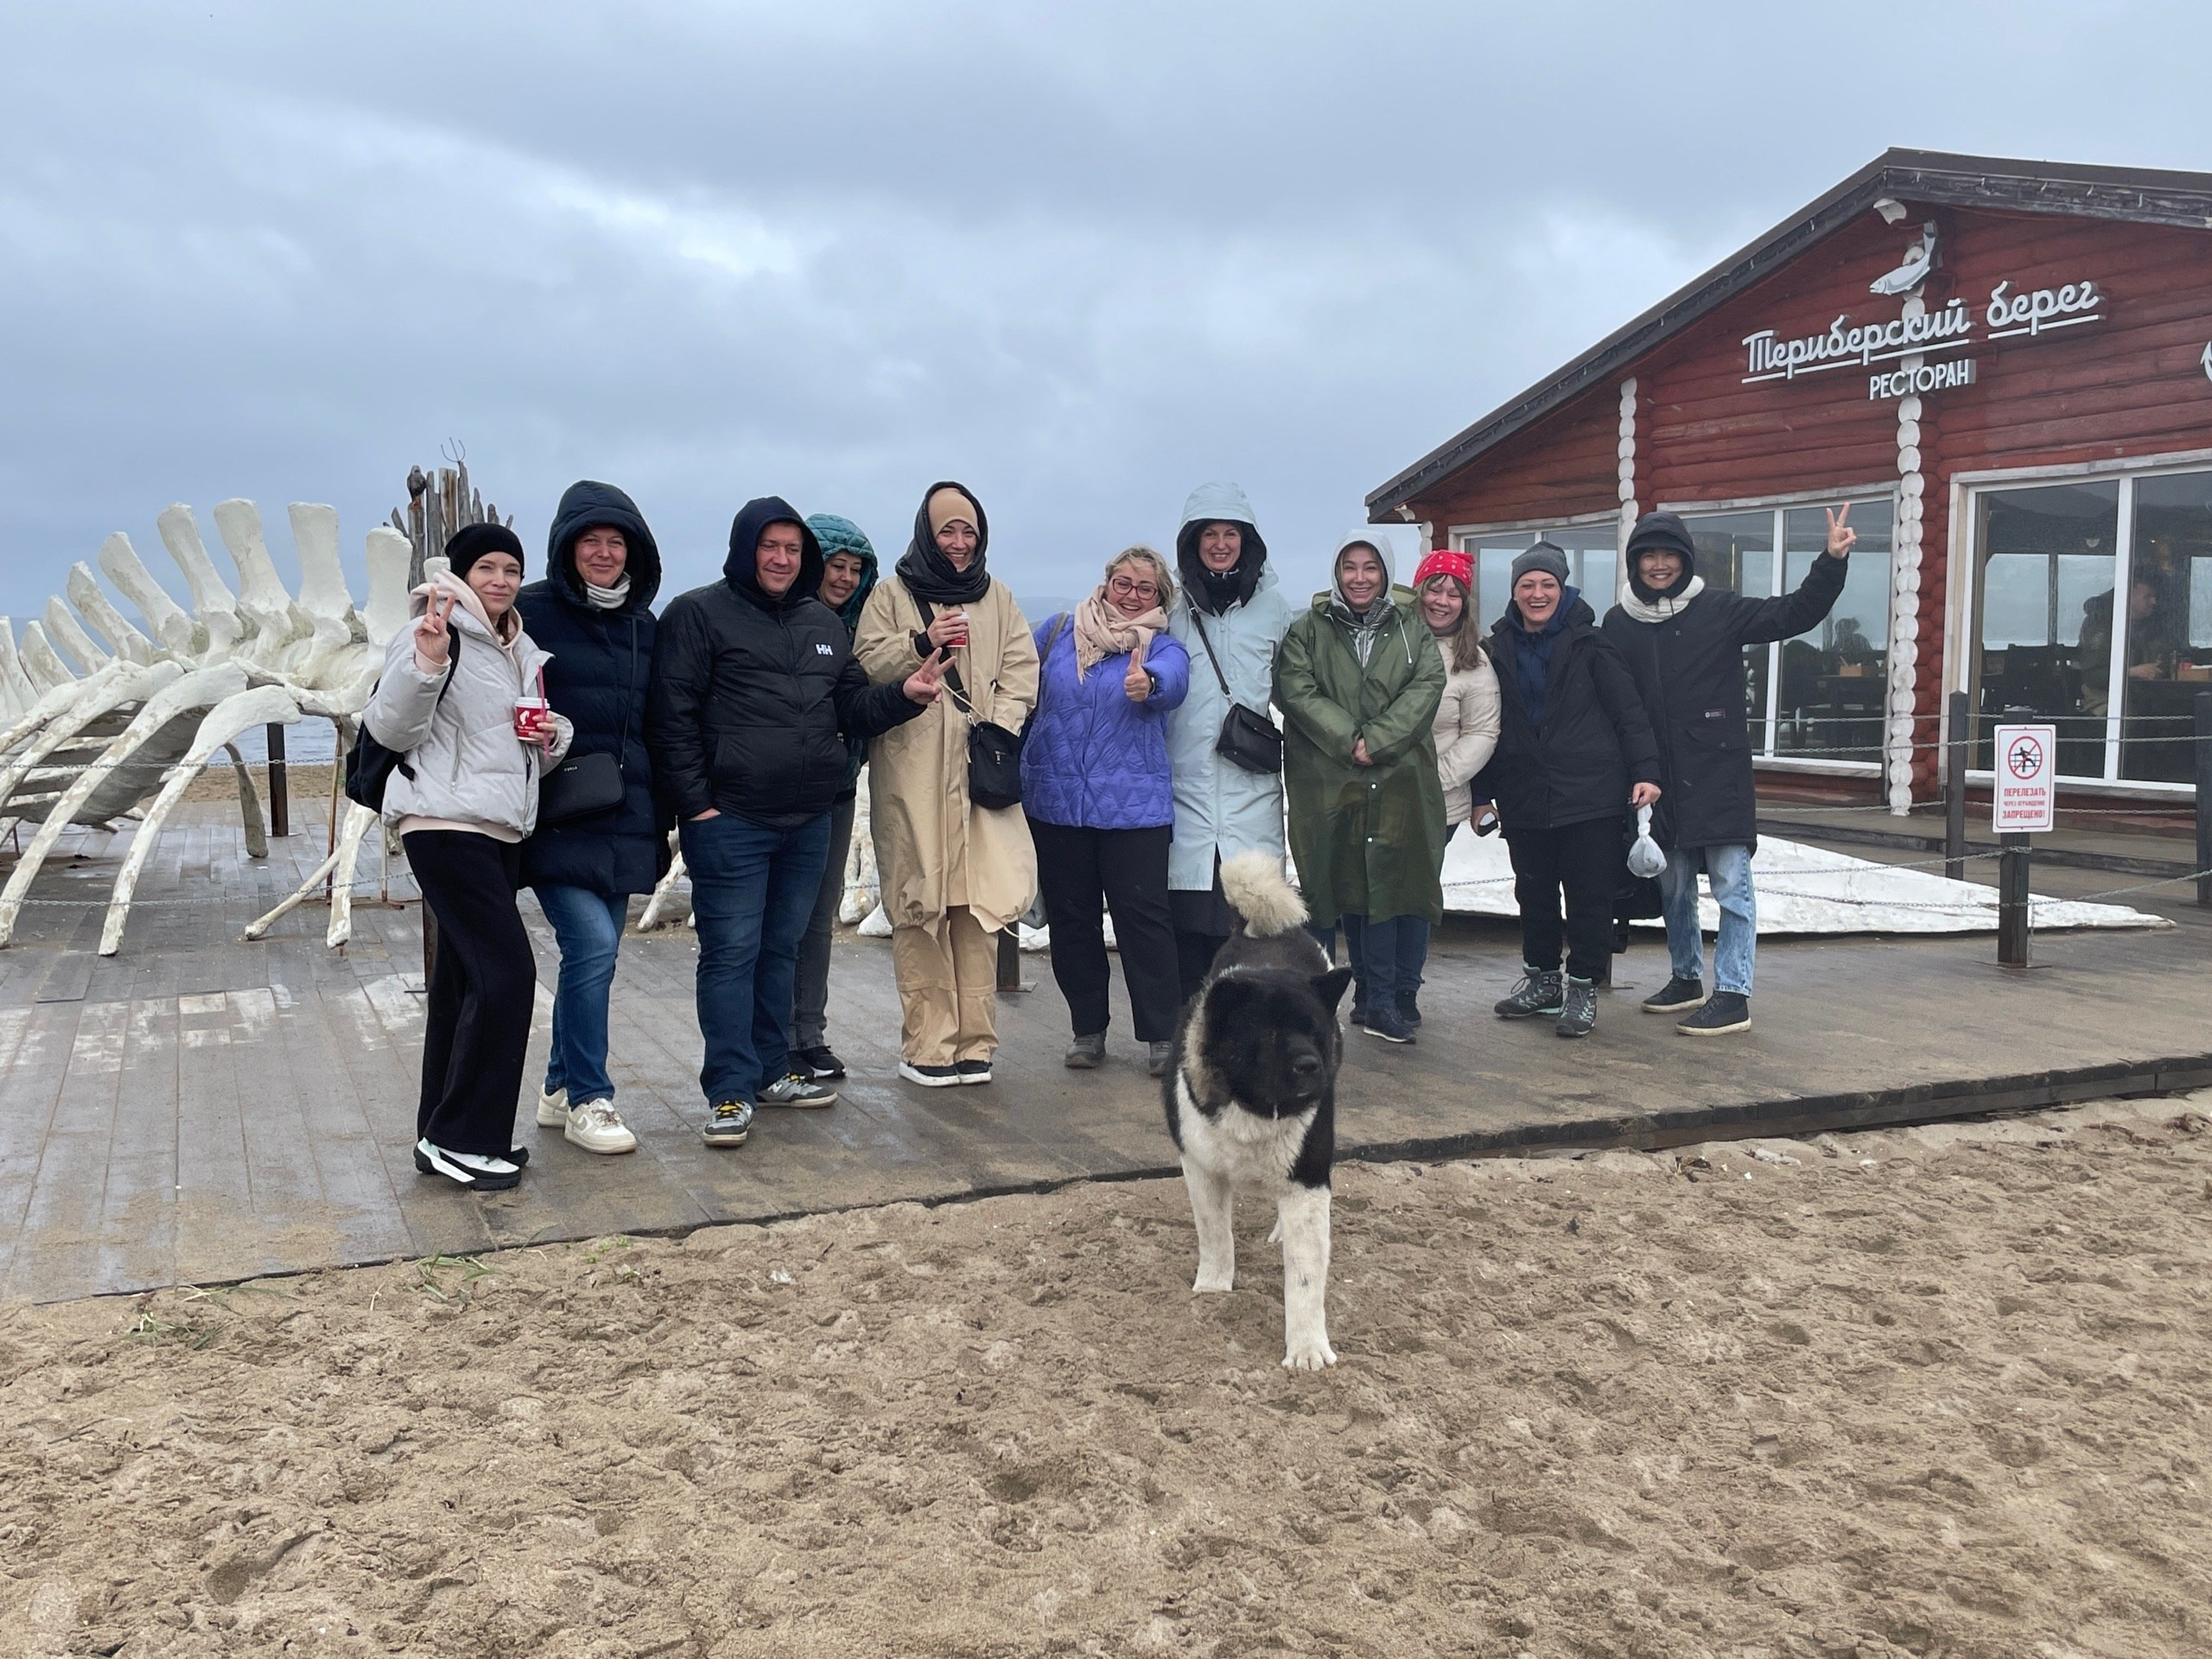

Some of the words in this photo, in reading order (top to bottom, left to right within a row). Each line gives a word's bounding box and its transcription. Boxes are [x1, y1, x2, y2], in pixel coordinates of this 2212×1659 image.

[1742, 298, 1971, 379] Териберский
[1987, 280, 2100, 335] берег
[1869, 359, 1970, 401] РЕСТОРАН
[815, 643, 834, 656] HH
[2004, 787, 2046, 797] ПЕРЕЛЕЗАТЬ
[2002, 810, 2045, 819] ЗАПРЕЩЕНО!
